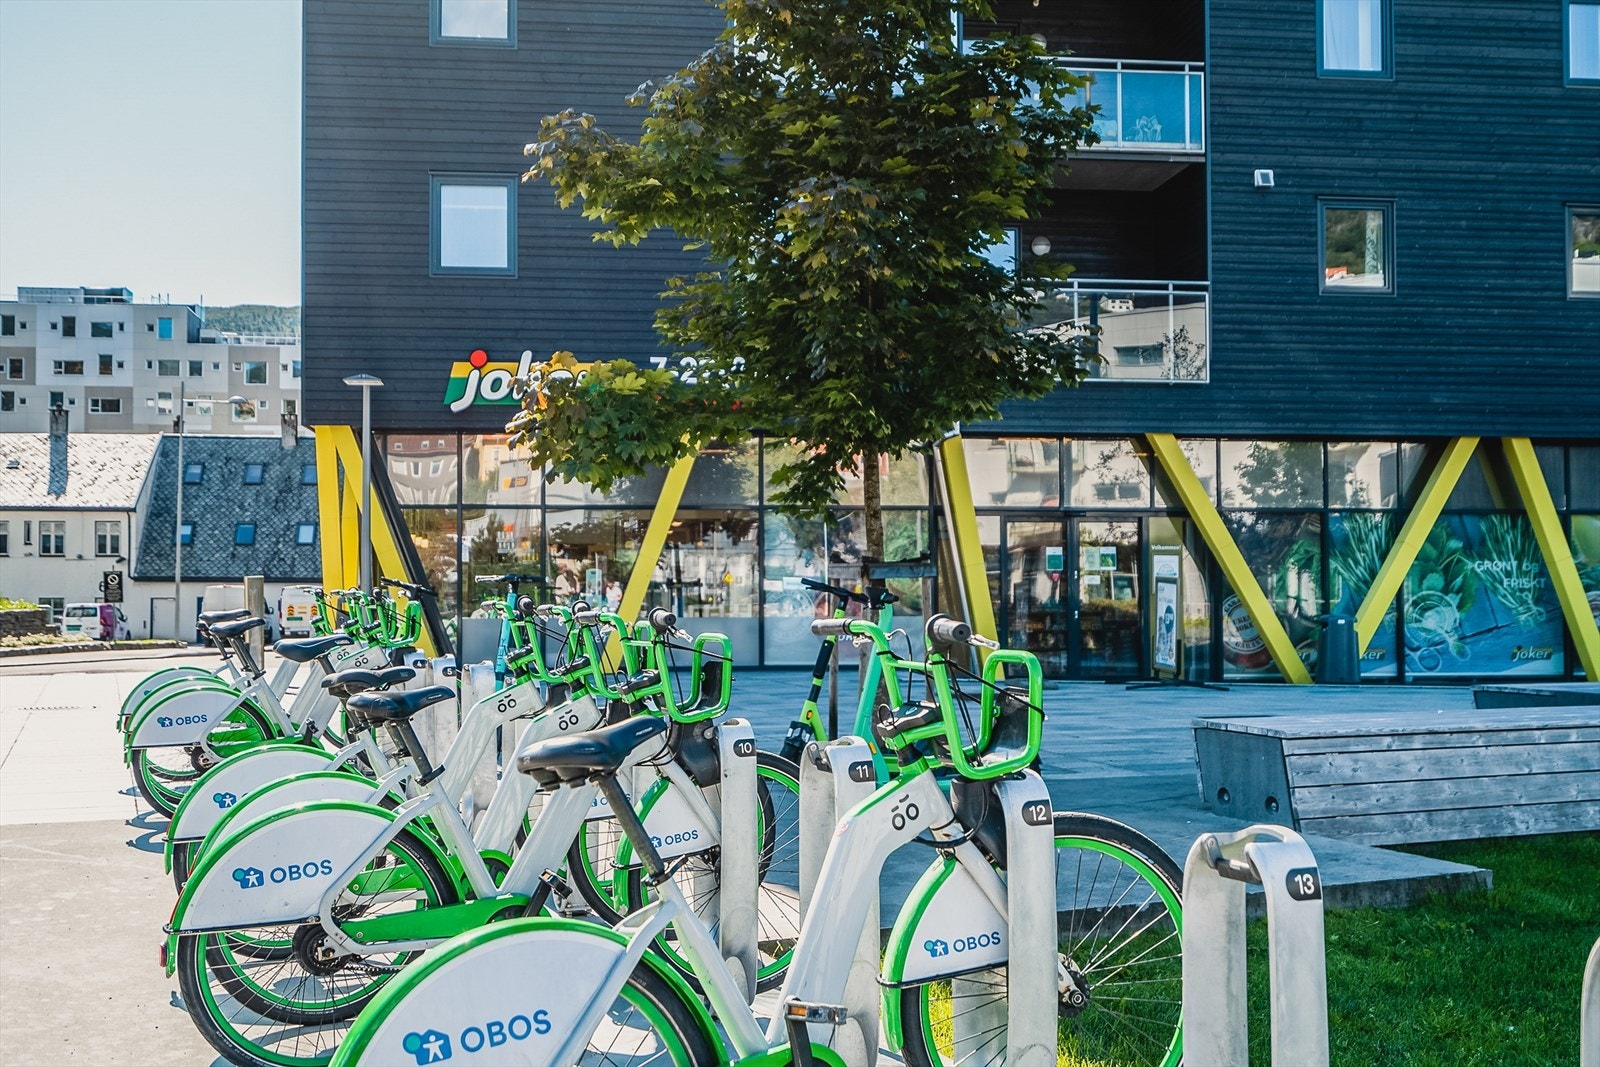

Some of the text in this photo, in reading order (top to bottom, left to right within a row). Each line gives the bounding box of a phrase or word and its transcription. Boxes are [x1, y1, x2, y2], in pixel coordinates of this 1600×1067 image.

[1474, 560, 1518, 571] GRØNT
[1503, 577, 1546, 588] FRISKT
[1512, 645, 1550, 662] joker
[175, 714, 208, 726] OBOS
[738, 742, 753, 754] 10
[855, 764, 870, 778] 11
[600, 793, 631, 806] OS
[1029, 804, 1047, 821] 12
[664, 829, 699, 846] OBOS
[270, 859, 333, 884] OBOS
[1294, 873, 1315, 895] 13
[953, 931, 1001, 953] OBOS
[460, 1009, 552, 1053] OBOS
